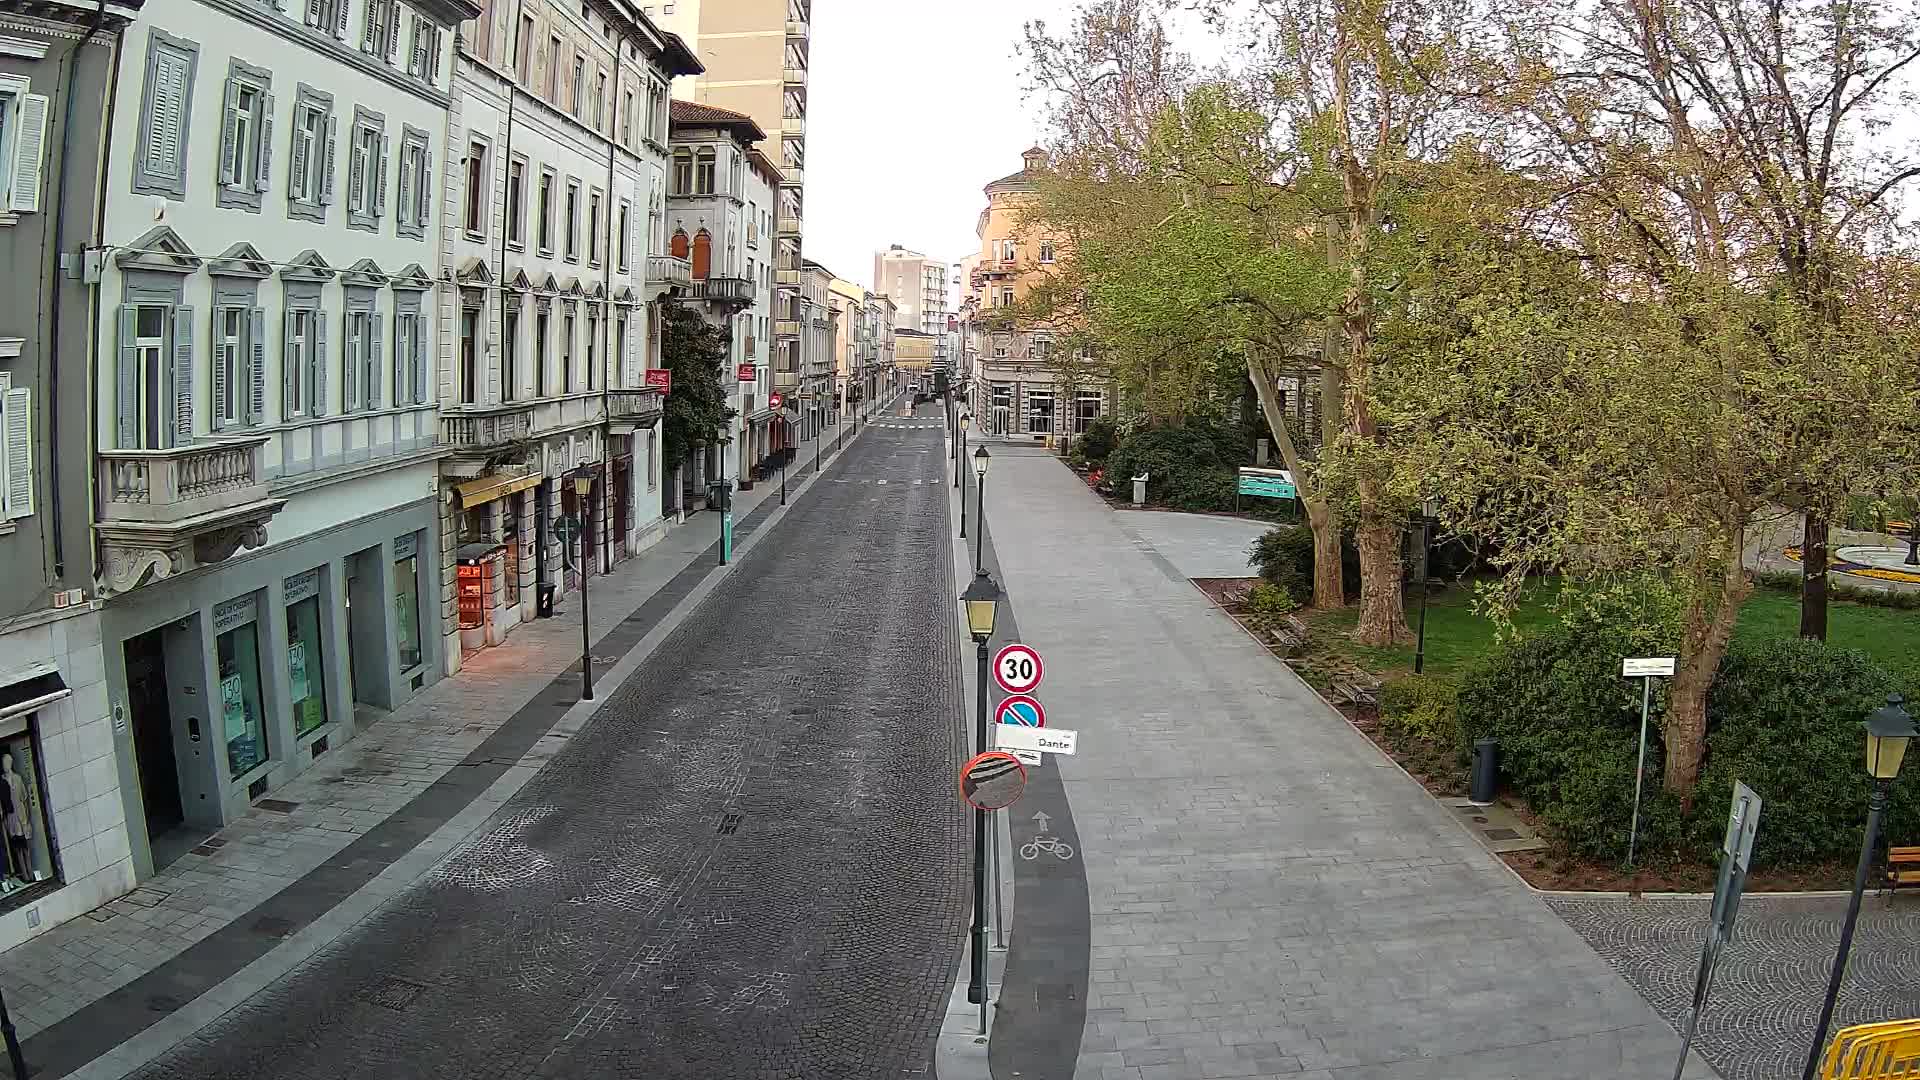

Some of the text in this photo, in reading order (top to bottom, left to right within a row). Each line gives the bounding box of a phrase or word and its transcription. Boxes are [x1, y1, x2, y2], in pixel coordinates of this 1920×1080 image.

[1006, 658, 1033, 679] 30
[222, 677, 241, 700] 130
[1038, 737, 1070, 749] Dante
